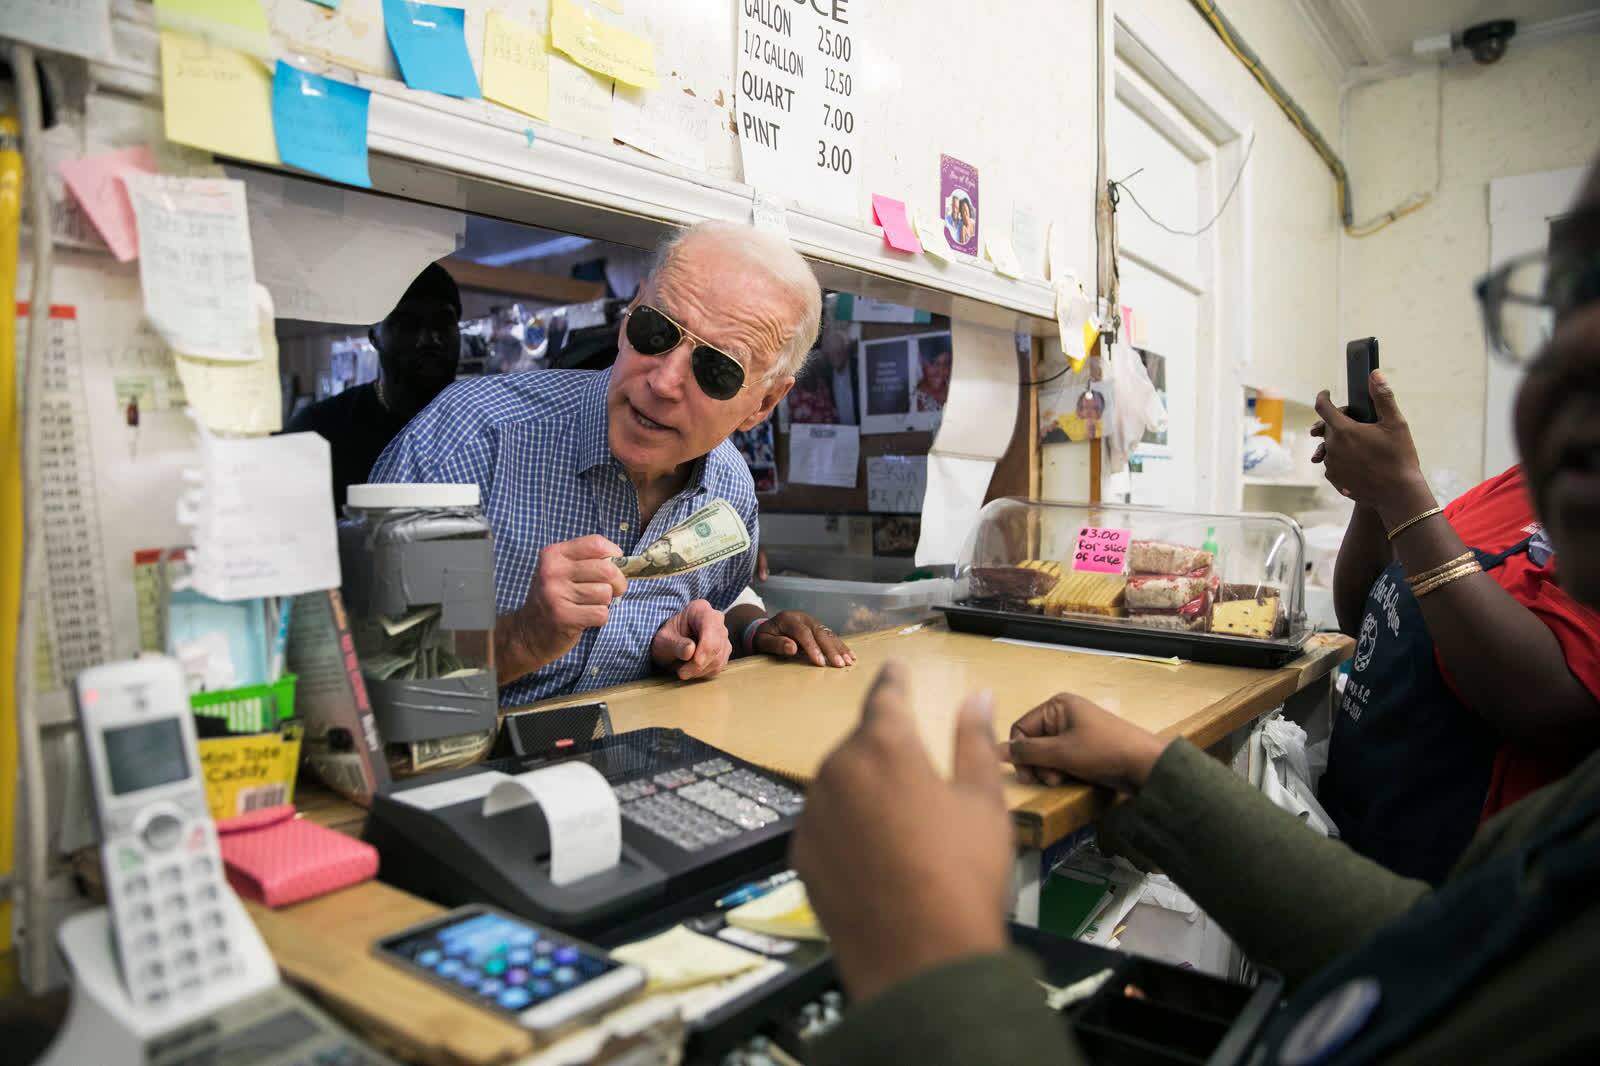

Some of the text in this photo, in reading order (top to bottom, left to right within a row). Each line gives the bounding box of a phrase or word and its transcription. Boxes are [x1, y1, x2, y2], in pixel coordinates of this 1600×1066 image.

[744, 0, 851, 62] GALLON 25.00
[744, 29, 852, 97] 1/2 GALLON 12.50
[742, 71, 854, 134] QUART 7.00
[743, 112, 780, 151] PINT
[817, 140, 852, 175] 3.00
